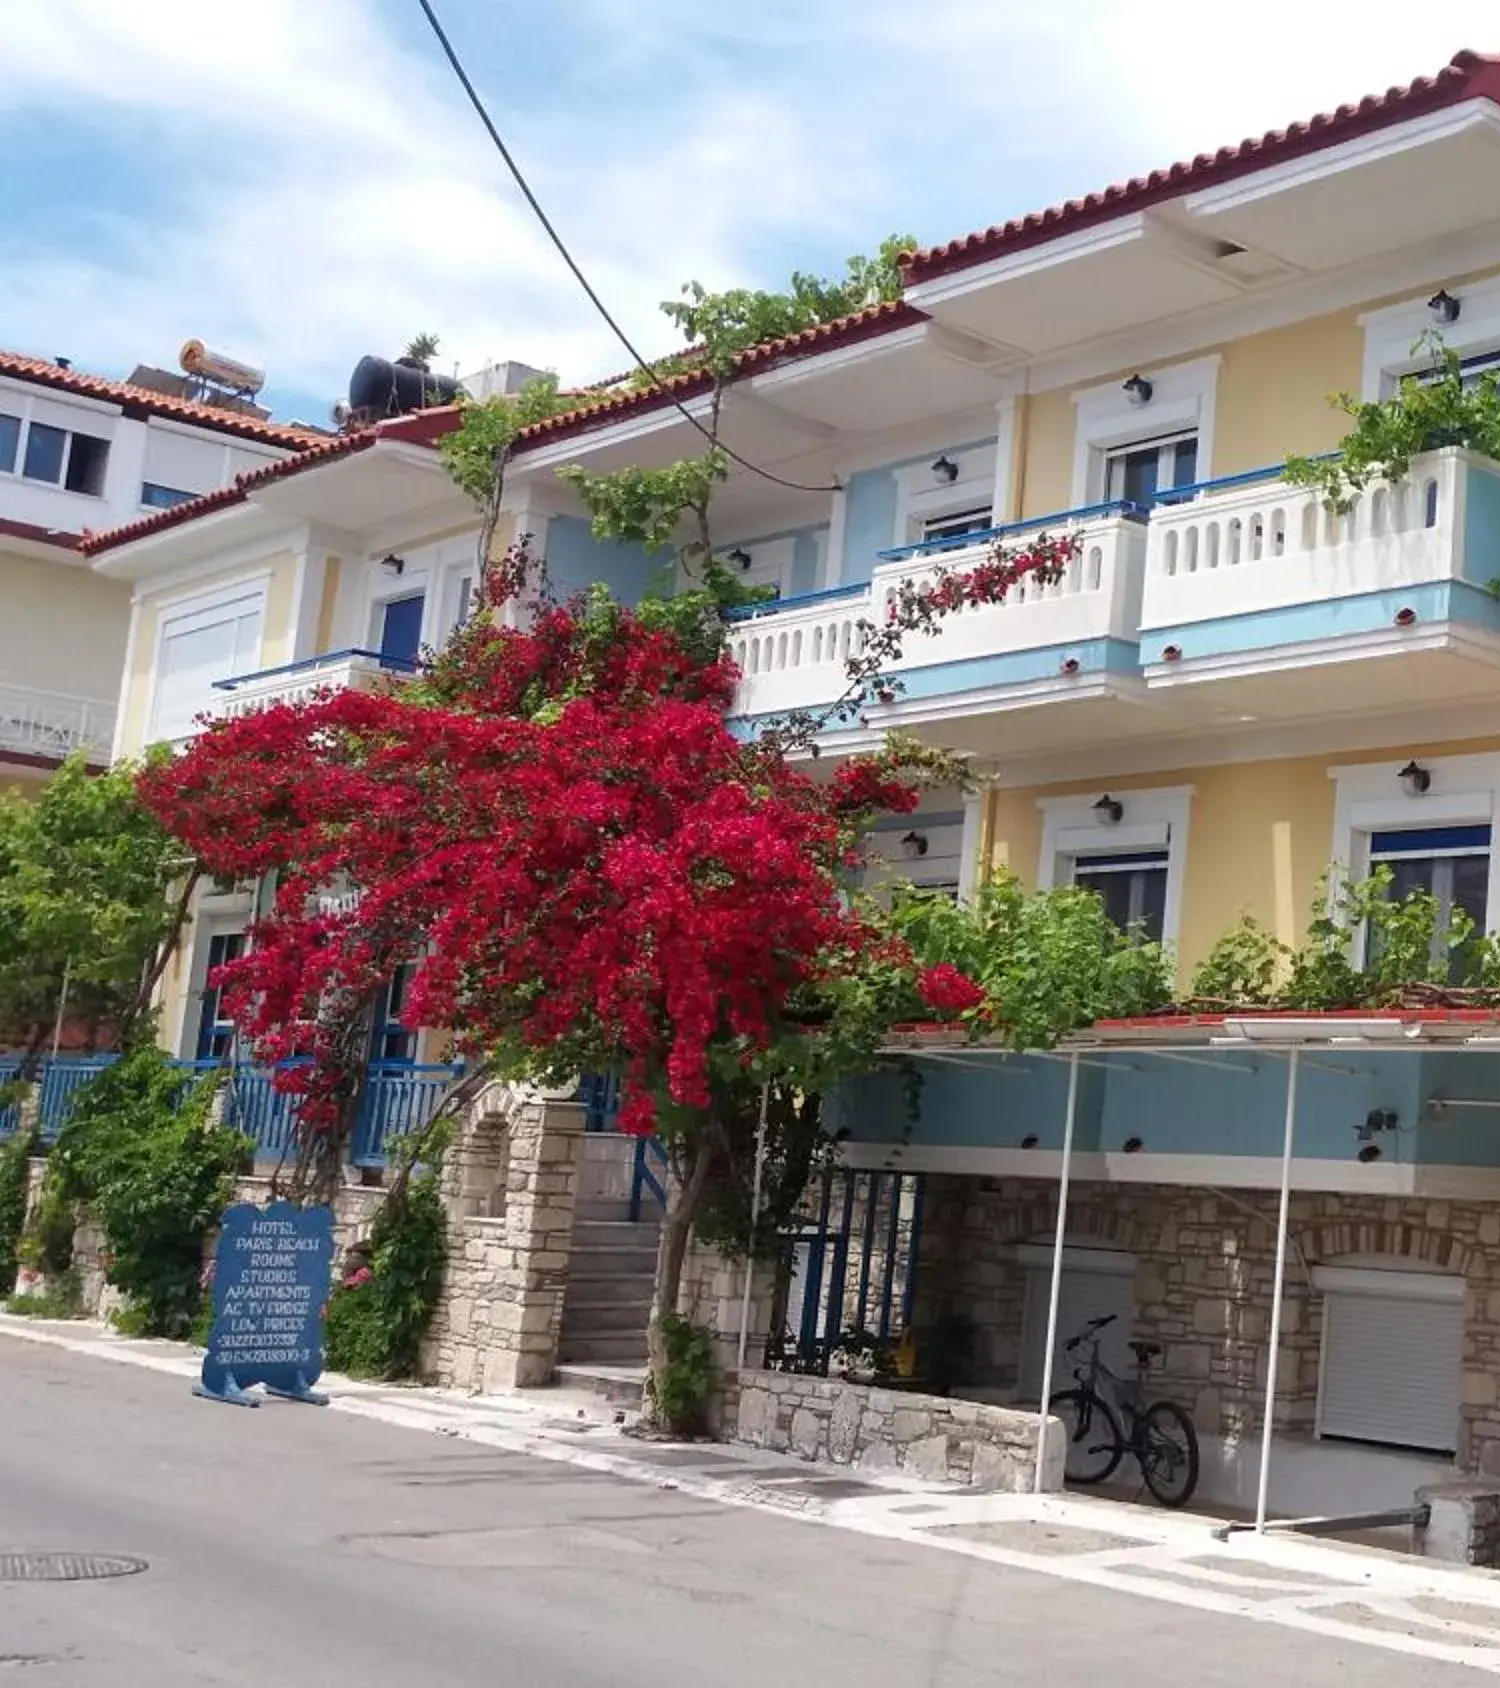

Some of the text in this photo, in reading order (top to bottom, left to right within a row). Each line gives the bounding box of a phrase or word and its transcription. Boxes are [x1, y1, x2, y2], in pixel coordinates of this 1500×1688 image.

[252, 1220, 296, 1235] HOTEL
[251, 1253, 295, 1267] ROOMS
[240, 1270, 296, 1283] STUDIOS
[226, 1286, 311, 1300] APARTMENTS
[223, 1302, 243, 1316] AC
[249, 1302, 265, 1315] TV
